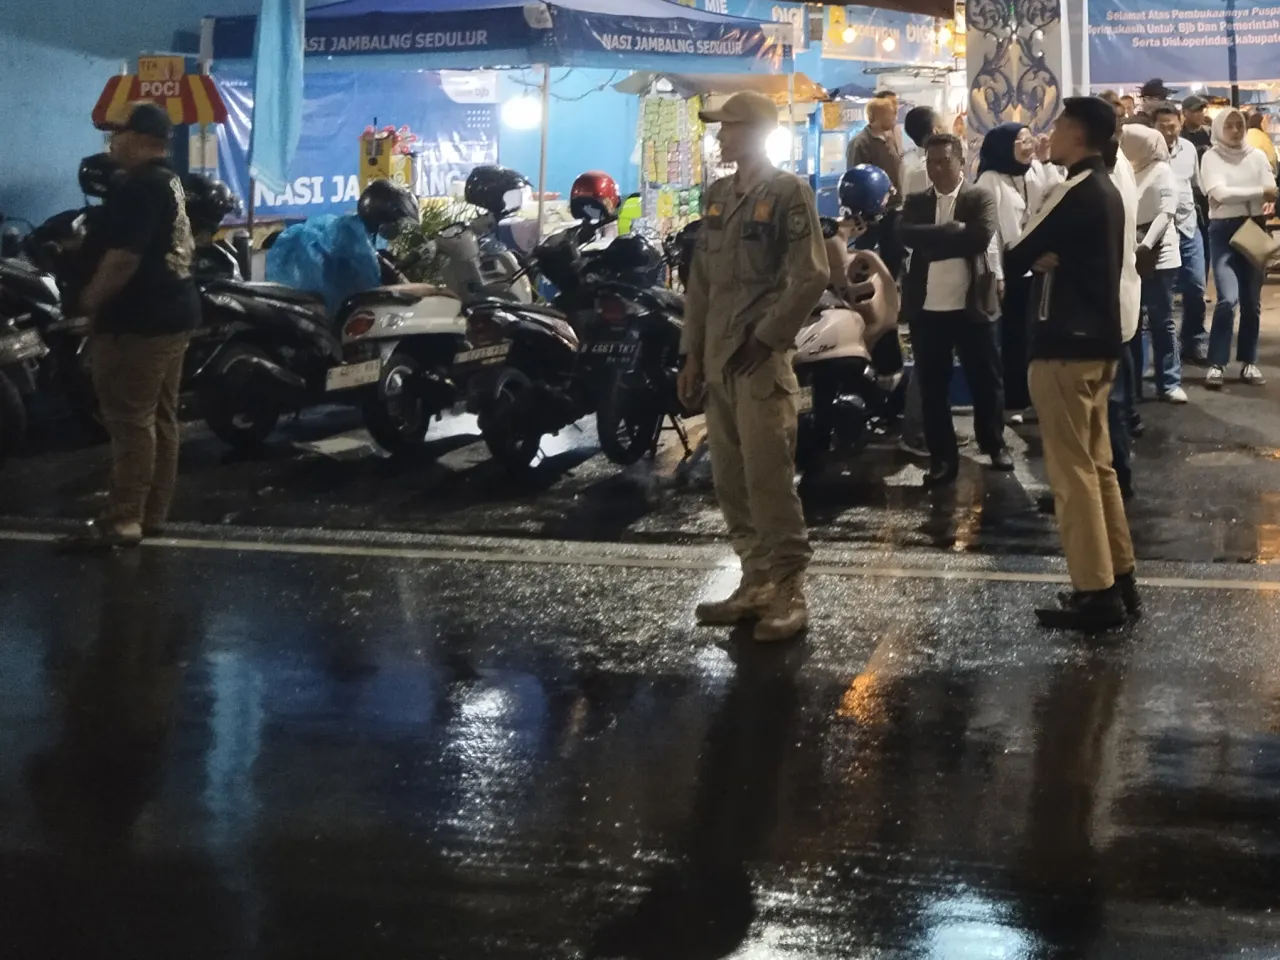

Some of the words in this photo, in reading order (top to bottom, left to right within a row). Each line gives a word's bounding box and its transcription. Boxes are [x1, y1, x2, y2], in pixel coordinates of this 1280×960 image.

[1106, 10, 1146, 21] Selamat
[1148, 9, 1169, 19] Atas
[1197, 21, 1218, 33] Dan
[330, 32, 412, 51] JAMBALNG
[415, 30, 488, 49] SEDULUR
[602, 33, 633, 50] NASI
[634, 35, 694, 54] JAMBALNG
[697, 39, 742, 55] SEDULUR
[1132, 37, 1161, 48] Serta
[140, 81, 180, 96] POCI
[254, 176, 324, 207] NASI
